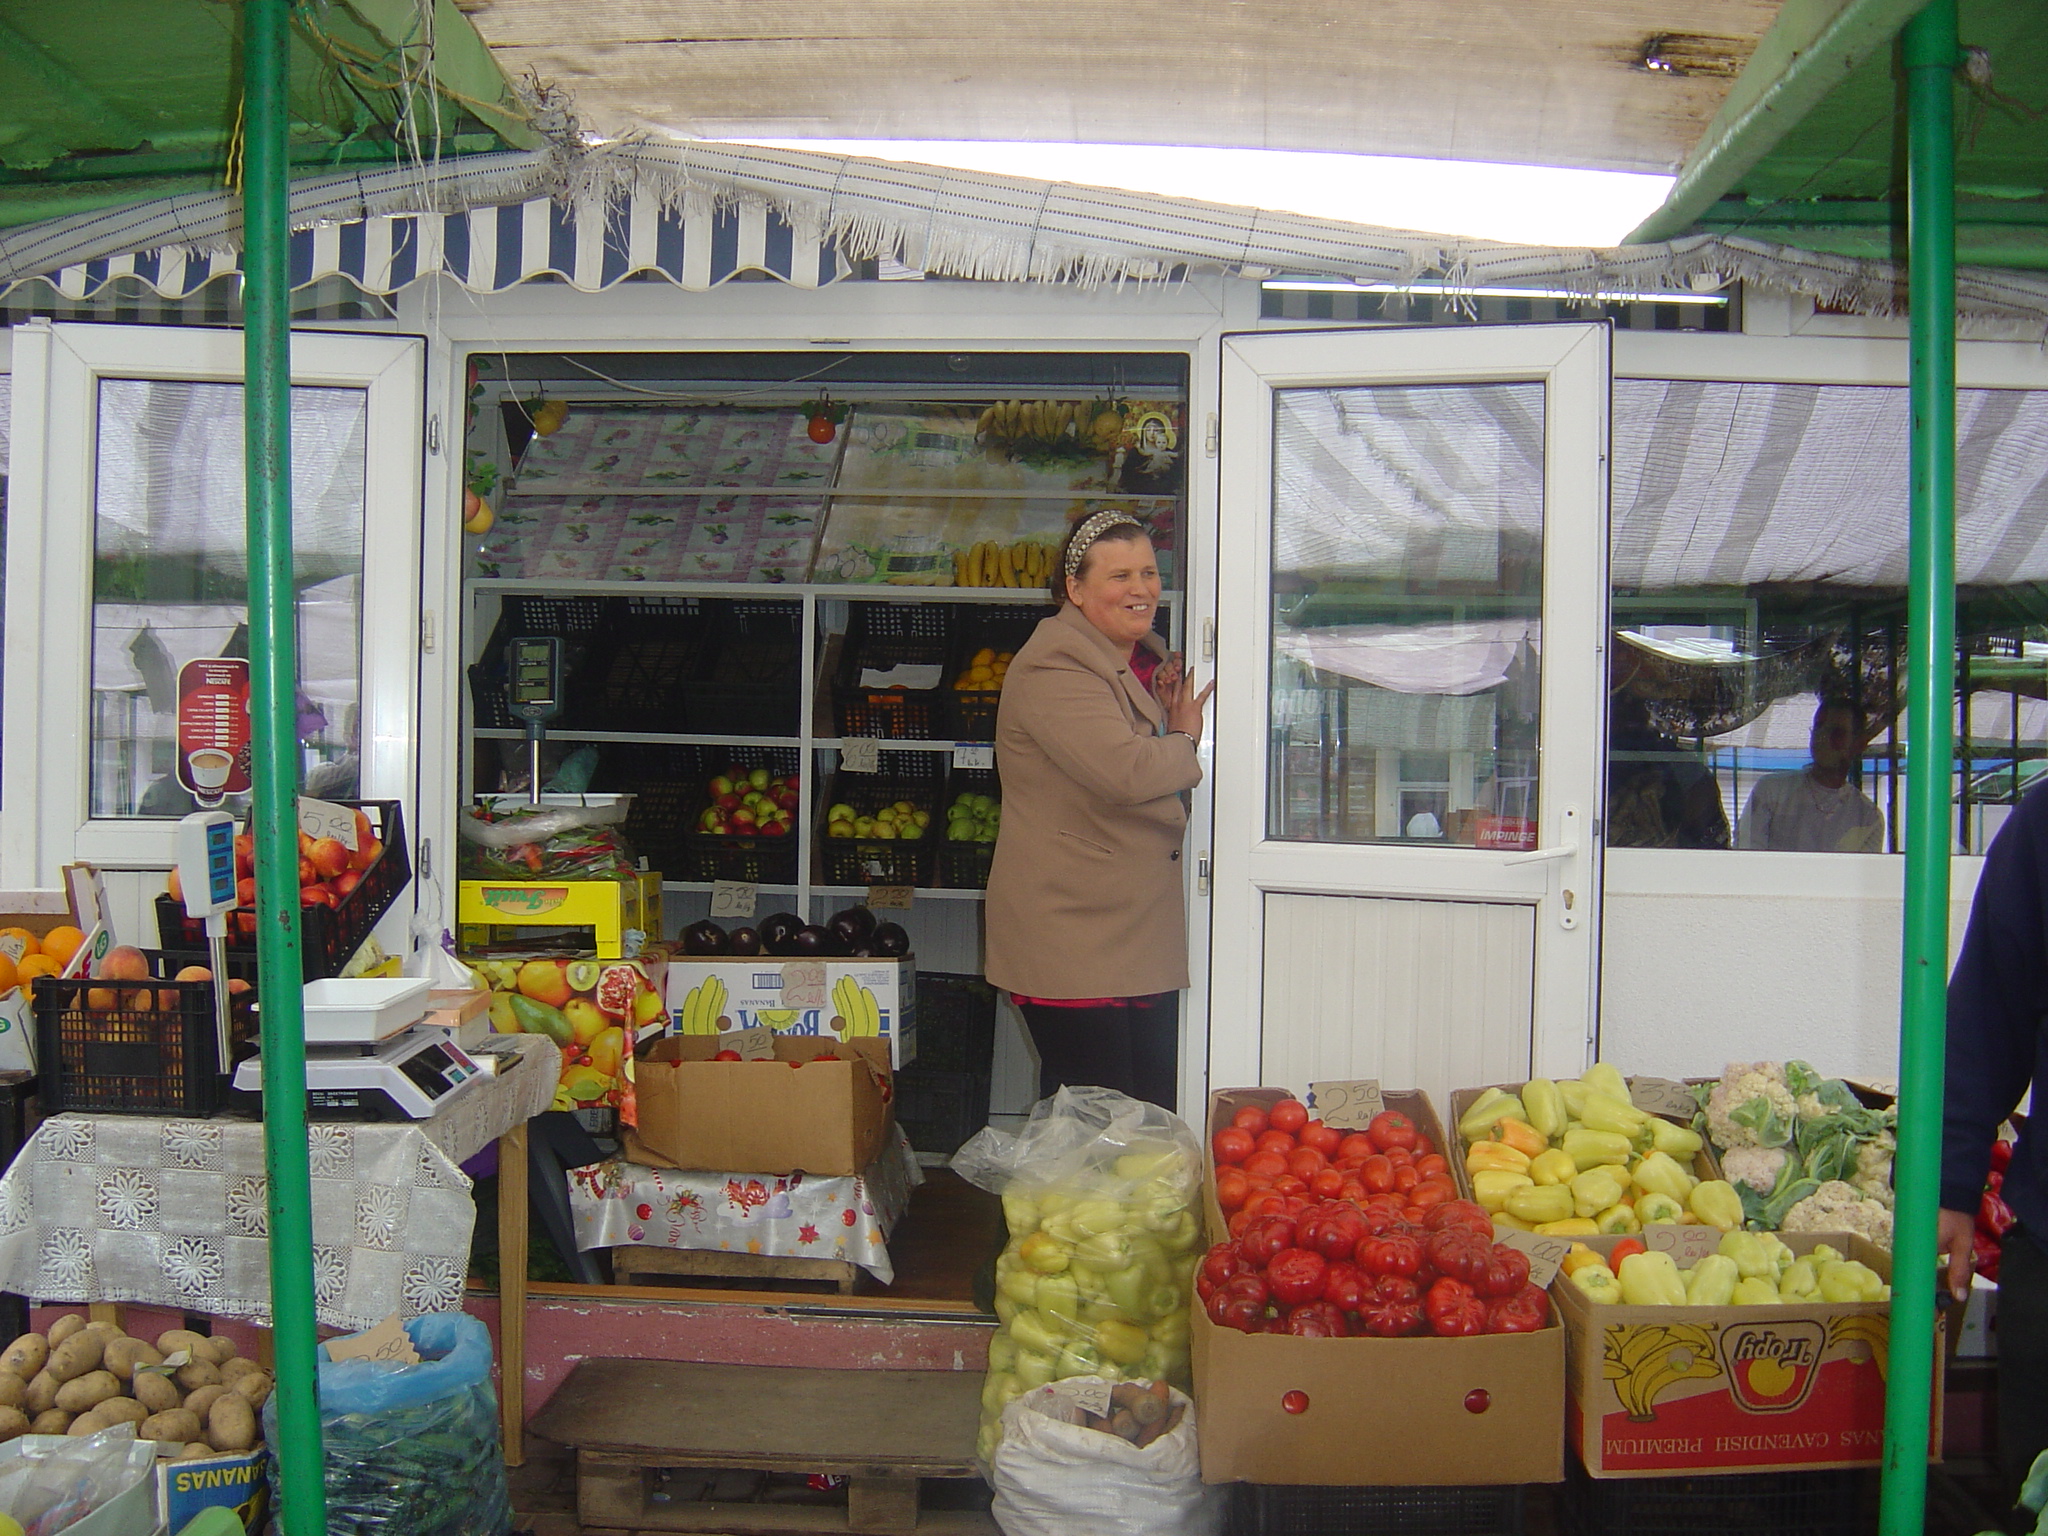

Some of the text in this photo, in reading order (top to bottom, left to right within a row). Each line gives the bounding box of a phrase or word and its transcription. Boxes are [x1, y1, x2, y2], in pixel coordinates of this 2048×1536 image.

[1735, 1330, 1815, 1369] Tropy
[1605, 1437, 1704, 1456] PREMIUM
[1715, 1431, 1830, 1451] CAVENDISH
[176, 1458, 267, 1493] ANANAS
